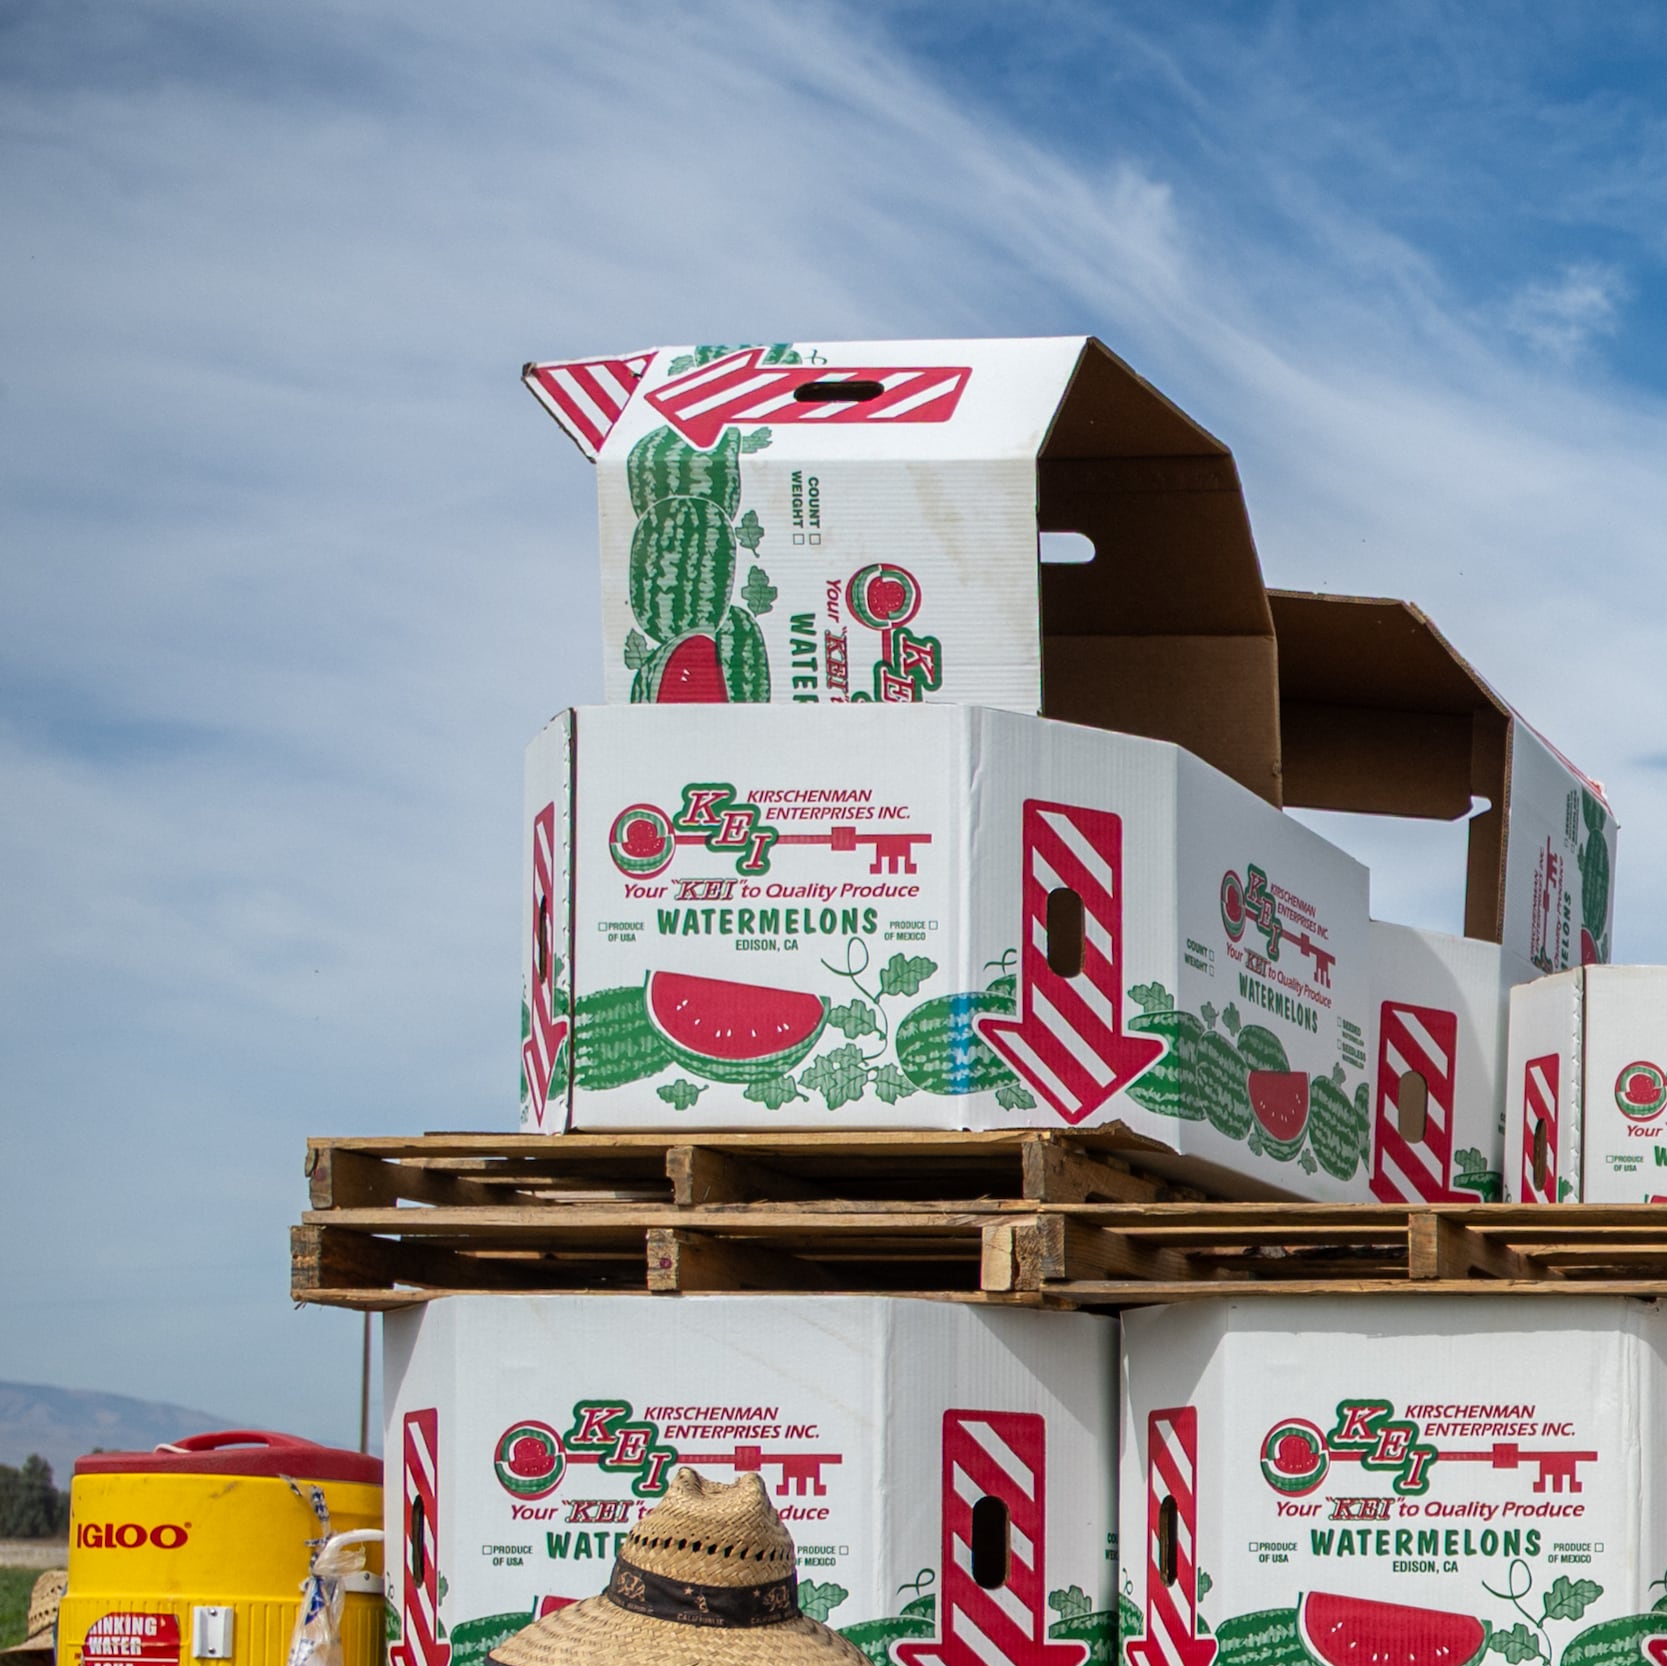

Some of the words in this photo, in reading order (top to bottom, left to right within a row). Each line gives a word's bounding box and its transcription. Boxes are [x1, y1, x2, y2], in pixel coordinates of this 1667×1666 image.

[792, 471, 804, 528] WEIGHT
[808, 477, 820, 528] COUNT
[826, 579, 841, 623] Your
[881, 634, 936, 703] KE
[747, 788, 873, 804] KIRSCHENMAN
[766, 805, 874, 822] ENTERPRISES
[877, 807, 912, 820] INC.
[677, 787, 774, 873] KEI
[623, 883, 667, 900] Your
[742, 883, 760, 898] to
[765, 882, 838, 903] Quality
[840, 881, 920, 898] Produce
[656, 905, 879, 938] WATERMELONS
[1226, 942, 1243, 963] Your
[1277, 970, 1304, 997] Quality
[1303, 984, 1332, 1009] Produce
[1239, 972, 1318, 1034] WATERMELONS
[644, 1406, 779, 1422] KIRSCHENMAN
[1405, 1404, 1536, 1420] KIRSCHENMAN
[664, 1424, 780, 1440] ENTERPRISES
[784, 1425, 821, 1440] INC.
[1424, 1421, 1537, 1438] ENTERPRISES
[1541, 1423, 1576, 1437] INC.
[569, 1404, 673, 1494] KEI
[1332, 1402, 1433, 1491] KEI
[509, 1504, 558, 1521] Your
[776, 1504, 829, 1520] duce
[1275, 1501, 1321, 1519] Your
[1400, 1502, 1418, 1517] to
[1423, 1501, 1500, 1523] Quality
[1502, 1501, 1586, 1518] Produce
[77, 1523, 188, 1549] IGLOO
[1310, 1526, 1542, 1559] WATERMELONS
[89, 1636, 142, 1655] WATER
